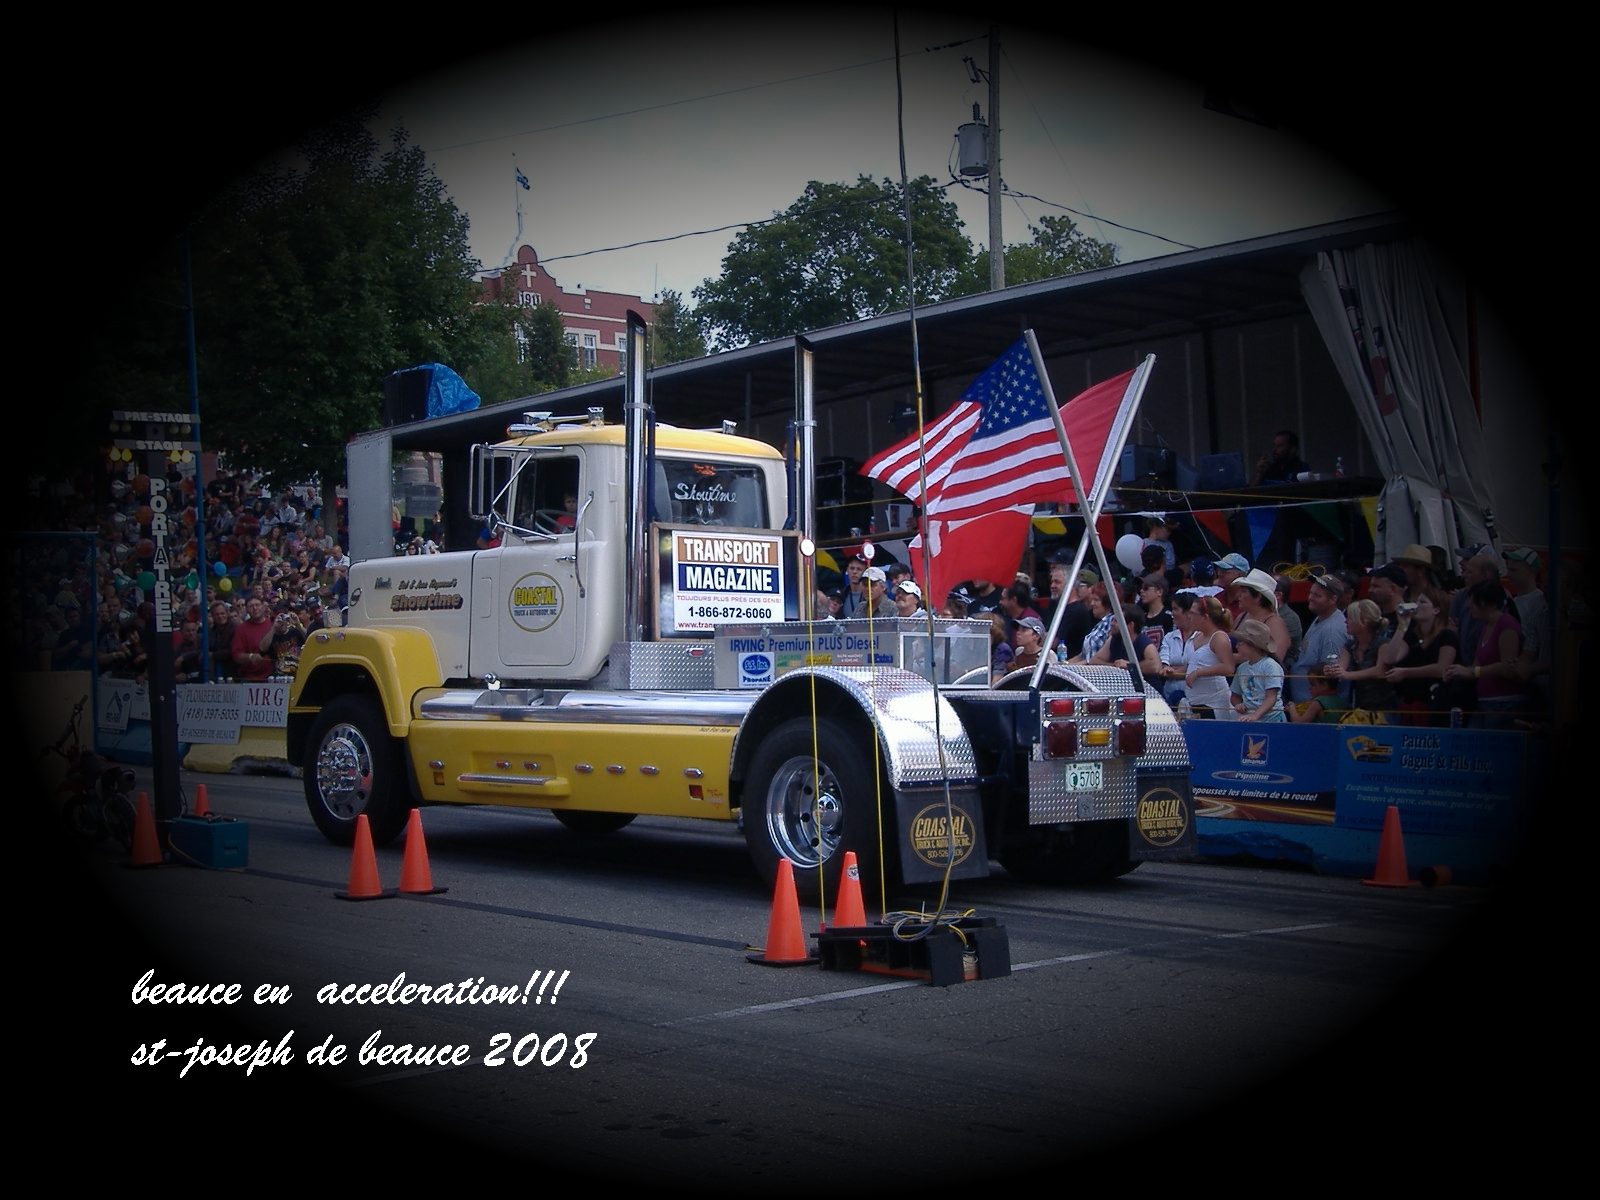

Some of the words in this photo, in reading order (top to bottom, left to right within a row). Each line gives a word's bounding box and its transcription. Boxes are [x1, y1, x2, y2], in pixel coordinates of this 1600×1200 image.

[124, 411, 191, 423] PRE-STAGE
[135, 440, 183, 450] STAGE
[674, 482, 737, 503] Showtime
[150, 478, 172, 633] PORTATREE
[684, 538, 771, 564] TRANSPORT
[686, 566, 773, 591] MAGAZINE
[391, 592, 463, 611] Showtime
[514, 586, 557, 606] COASTAL
[688, 606, 772, 619] 1-866-872-6060
[730, 639, 764, 652] IRVING
[769, 638, 814, 652] Premium
[818, 637, 842, 650] PLUS
[846, 636, 879, 650] Diesel
[743, 675, 771, 683] PROPANE
[186, 689, 223, 704] PLOMBERIE
[247, 688, 284, 706] MRG
[182, 708, 204, 722] (418)
[245, 709, 282, 723] DROUIN
[1402, 734, 1440, 750] Patrick
[1400, 752, 1435, 773] Gagné
[1436, 755, 1448, 771] &
[1450, 755, 1470, 772] Fils
[1473, 756, 1494, 773] inc.
[1080, 770, 1101, 787] 5708
[1235, 772, 1270, 781] Pipeline
[1361, 773, 1426, 785] ENTREPRENEUR
[1192, 787, 1227, 796] epoussez
[1228, 788, 1239, 796] les
[1241, 789, 1268, 798] limites
[1269, 790, 1281, 799] de
[1282, 791, 1290, 800] la
[1291, 793, 1319, 802] route!
[1356, 794, 1386, 803] Transport
[1140, 799, 1180, 818] COASTAL
[915, 816, 966, 837] COASAL
